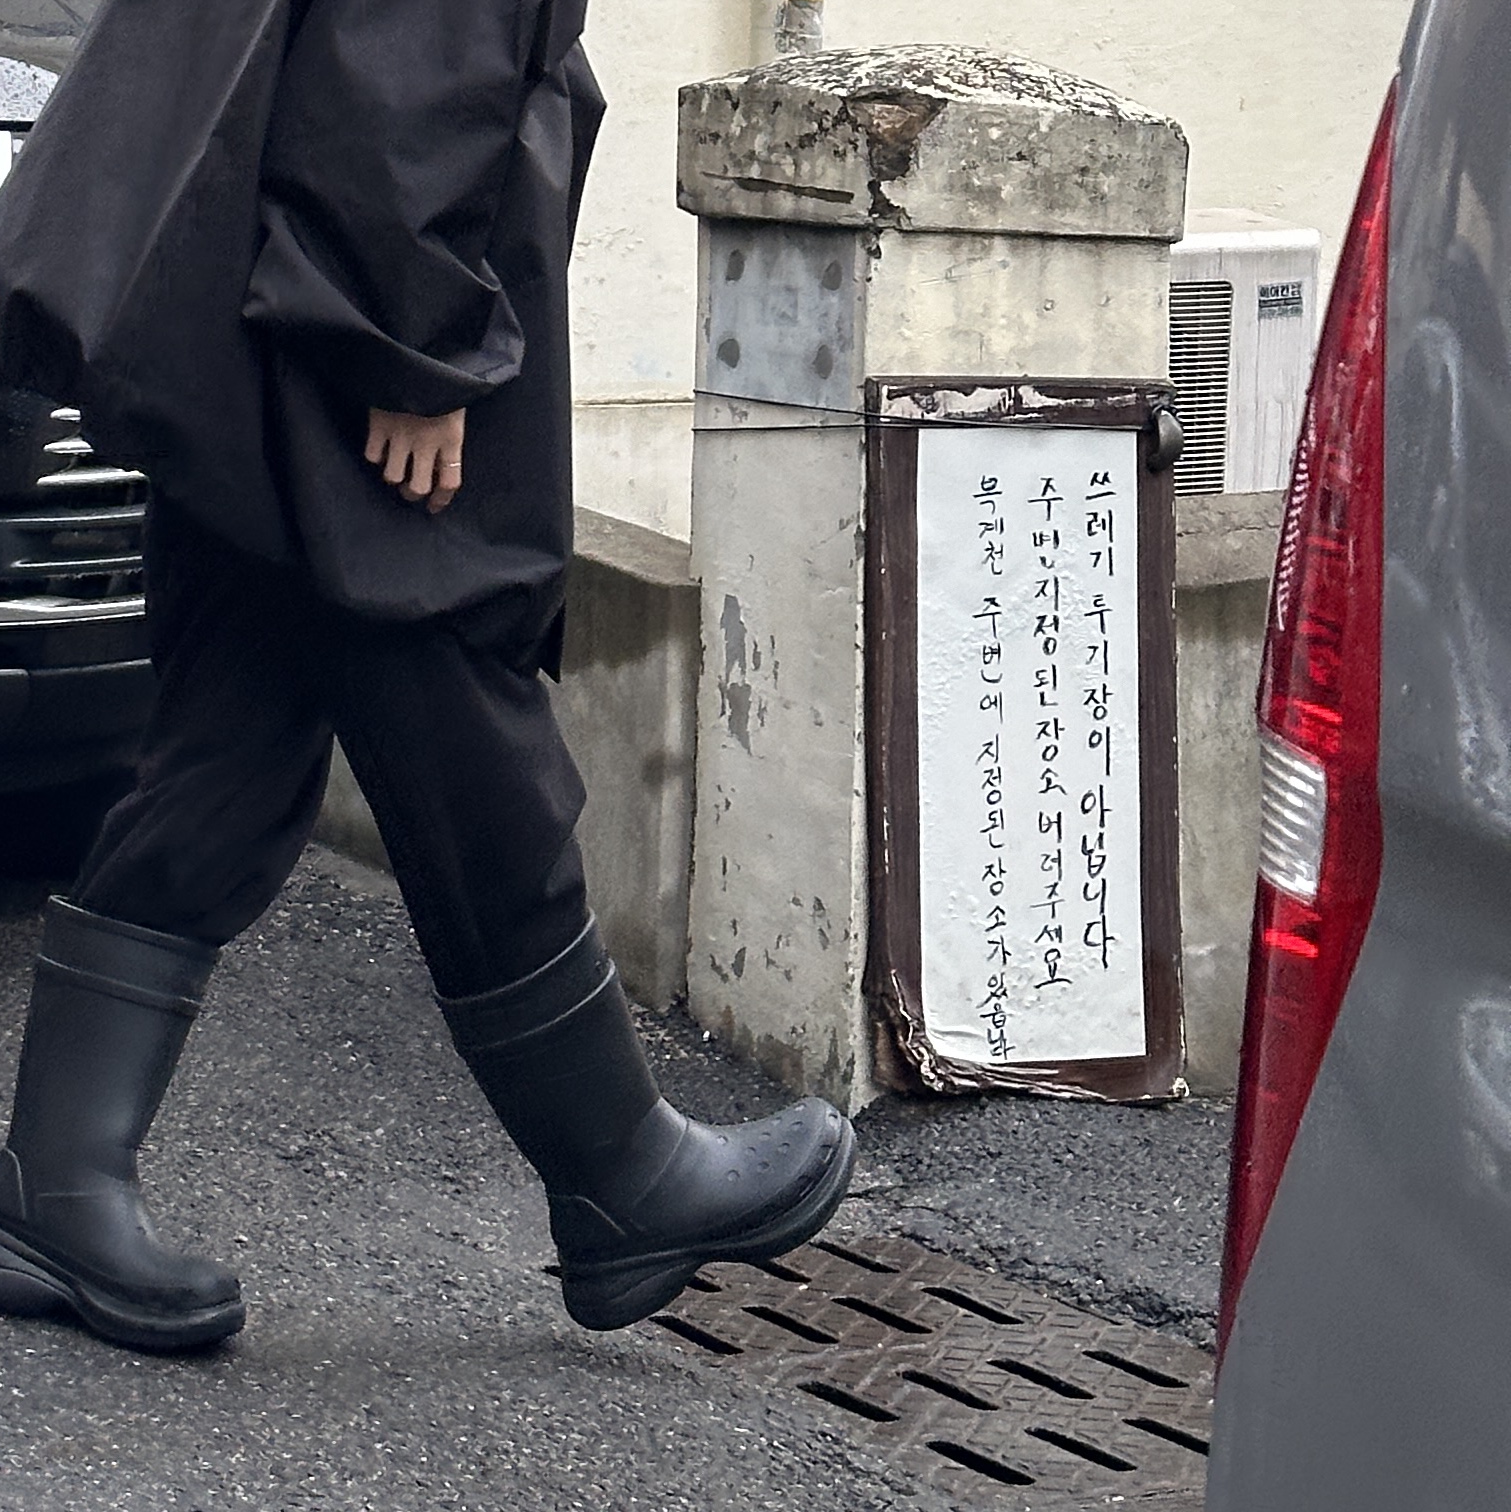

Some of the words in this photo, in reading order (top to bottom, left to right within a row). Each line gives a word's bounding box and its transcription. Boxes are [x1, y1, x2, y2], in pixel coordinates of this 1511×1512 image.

[1085, 471, 1117, 577] 쓰레기
[972, 597, 1004, 725] 주변에
[975, 733, 1006, 849] 지정된
[981, 856, 1013, 966] 장소가
[1080, 784, 1117, 970] 아닙니다
